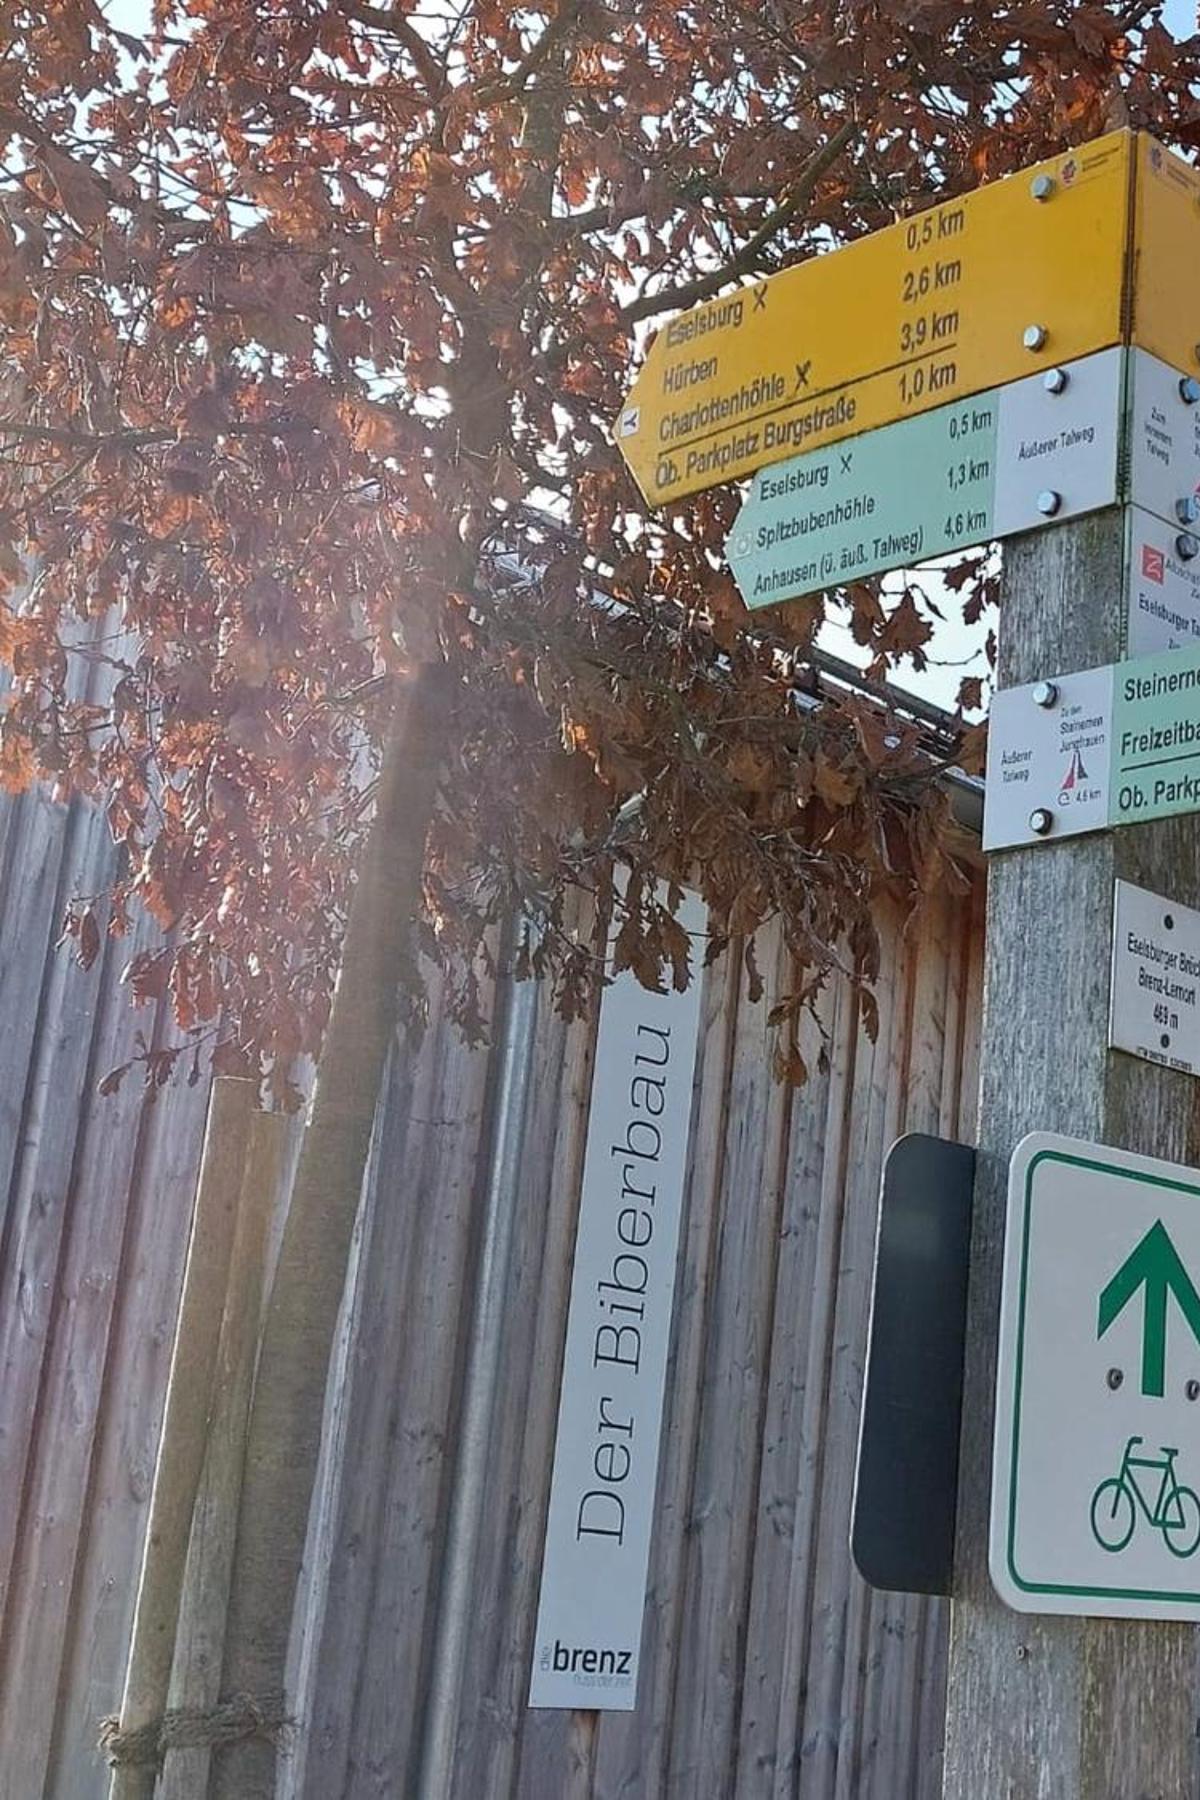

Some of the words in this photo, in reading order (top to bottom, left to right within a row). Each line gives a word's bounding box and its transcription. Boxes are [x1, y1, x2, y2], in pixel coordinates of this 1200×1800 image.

[666, 301, 743, 346] Eselsburg
[906, 216, 932, 250] 0,5
[938, 207, 964, 234] km
[663, 357, 718, 393] Hürben
[903, 270, 929, 301] 2,6
[935, 258, 961, 286] km
[660, 373, 785, 442] Charlottenhöhle
[900, 319, 926, 351] 3,9
[931, 310, 959, 338] km
[655, 459, 682, 488] Ob.
[686, 431, 760, 478] Parkplatz
[764, 398, 856, 449] Burgstraße
[899, 369, 924, 402] 1,0
[928, 361, 957, 390] km
[760, 465, 829, 501] Eselsburg
[950, 415, 969, 439] 0,5
[972, 409, 992, 431] km
[1018, 438, 1057, 461] Äußerer
[1059, 427, 1095, 448] Talweg
[756, 495, 875, 549] Spitzbubenhöhle
[947, 464, 967, 489] 1,3
[969, 459, 989, 481] km
[753, 563, 817, 595] Anhausen
[872, 525, 923, 561] Talweg)
[944, 515, 964, 538] 4,6
[966, 509, 987, 533] km
[1138, 593, 1190, 631] Eselsburger
[1089, 789, 1101, 801] km
[1119, 786, 1148, 811] Ob.
[1127, 932, 1178, 971] Eselsburger
[1170, 1013, 1179, 1029] m
[594, 1024, 671, 1374] Biberbau
[576, 1396, 634, 1546] Der
[553, 1639, 632, 1674] brenz
